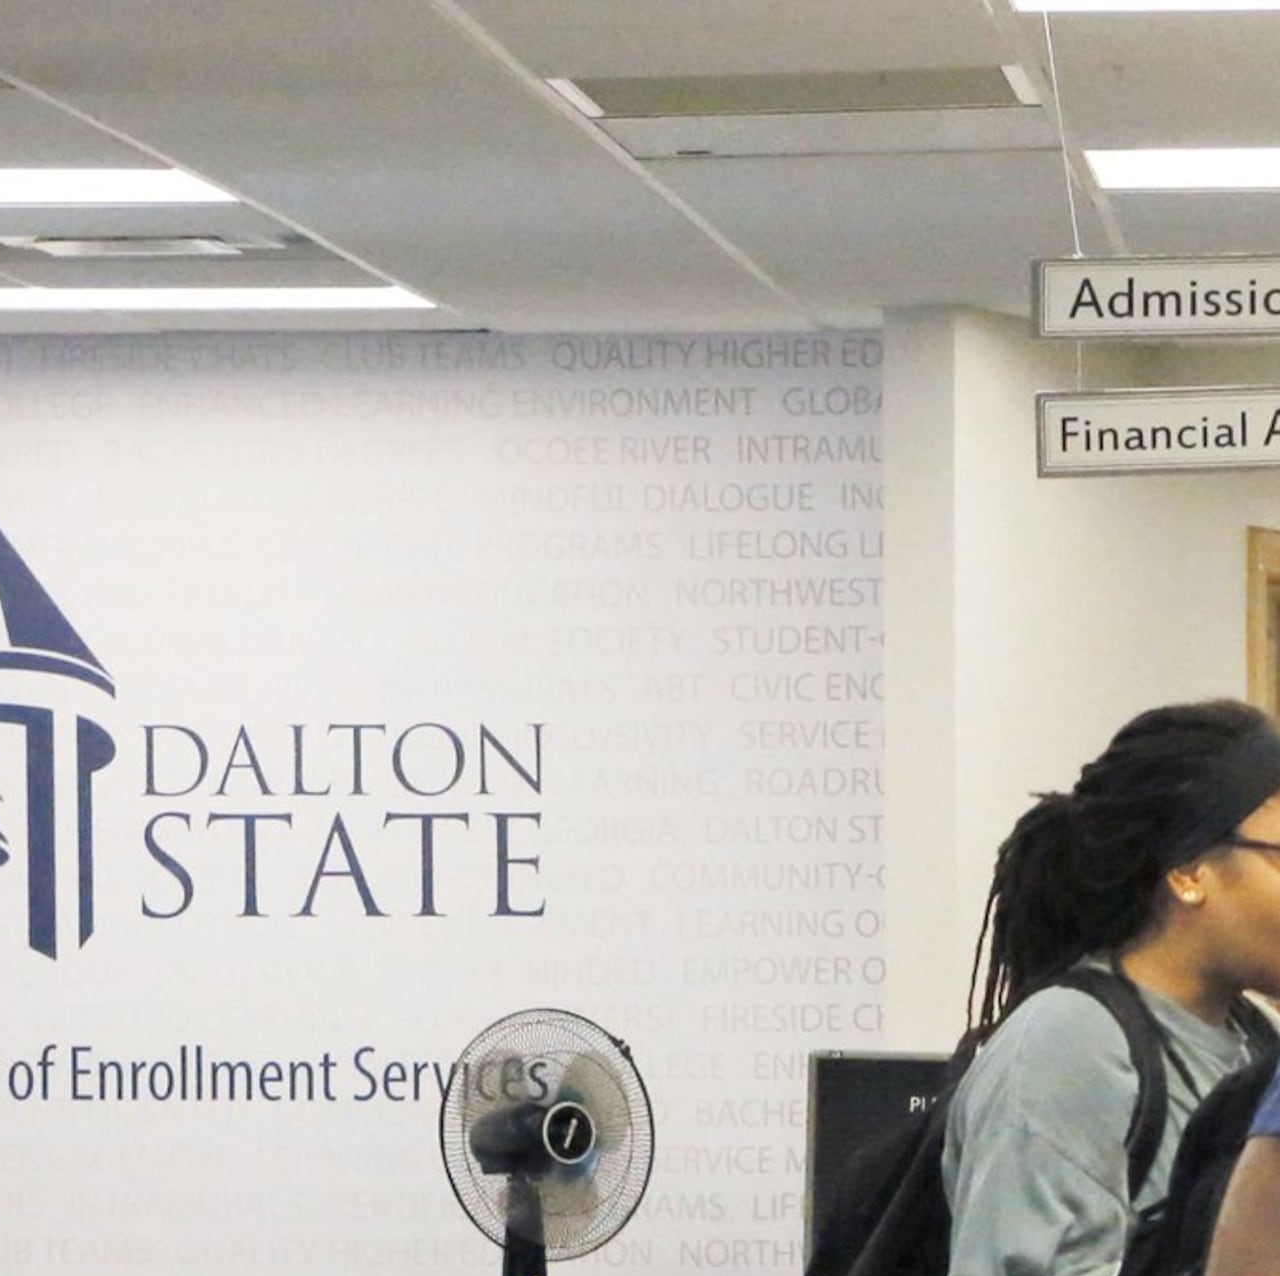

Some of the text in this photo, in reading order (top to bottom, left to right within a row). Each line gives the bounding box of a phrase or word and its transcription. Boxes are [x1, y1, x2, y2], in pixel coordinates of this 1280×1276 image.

[552, 339, 694, 368] QUALITY
[704, 338, 828, 368] HIGHER
[513, 387, 757, 417] ENVIRONMENT
[1058, 412, 1249, 455] Financial
[622, 435, 711, 464] RIVER
[643, 482, 814, 512] DIALOGUE
[689, 530, 848, 559] LIFELONG
[713, 625, 884, 655] STUDENT-
[730, 673, 814, 702] CIVIC
[738, 720, 870, 749] SERVICE
[141, 722, 546, 797] DALTON
[141, 810, 548, 920] STATE
[701, 1003, 842, 1033] FIRESIDE
[8, 1045, 57, 1102] of
[70, 1045, 337, 1102] Enrollment
[353, 1045, 550, 1103] Services
[658, 1145, 773, 1175] ERVICE
